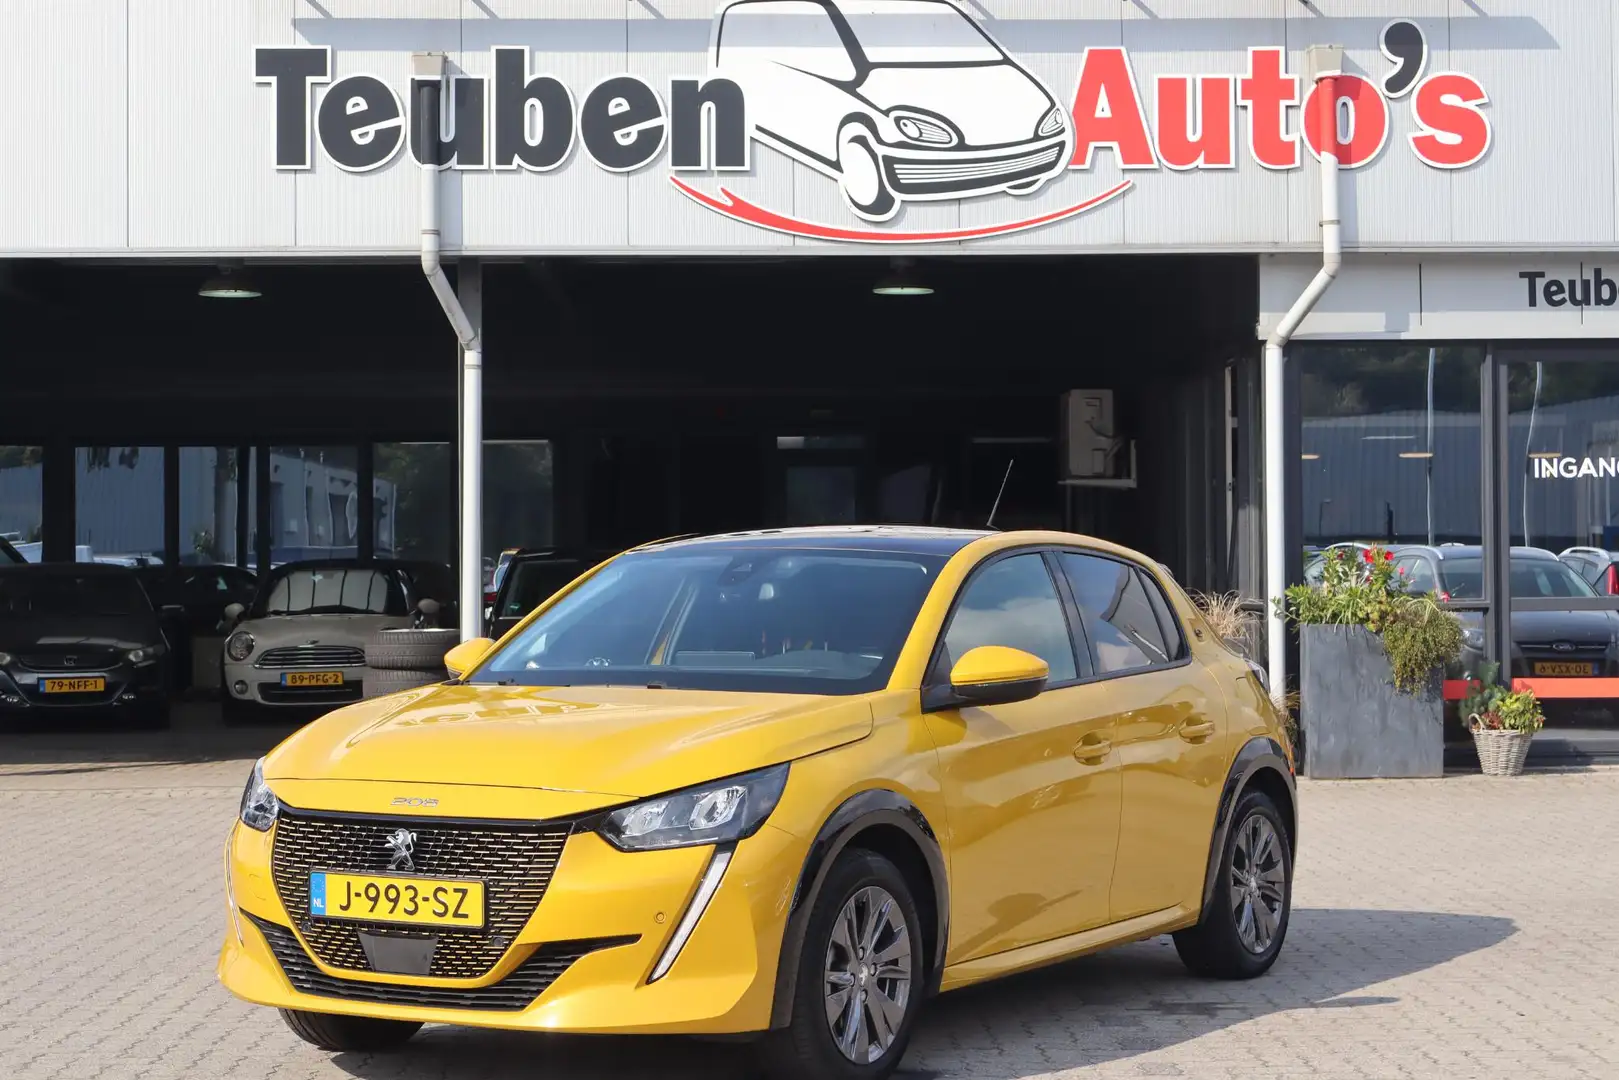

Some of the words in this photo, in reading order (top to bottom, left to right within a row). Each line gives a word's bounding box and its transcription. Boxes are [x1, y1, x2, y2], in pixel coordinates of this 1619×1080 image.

[255, 47, 748, 171] Teuben
[1068, 19, 1491, 168] Auto's
[1519, 268, 1619, 307] Teub
[1534, 457, 1619, 478] INGAN
[50, 680, 98, 691] 79-NFF-1
[290, 673, 340, 685] 89-PFG-2
[313, 897, 325, 908] NL
[339, 881, 469, 919] J-993-SZ
